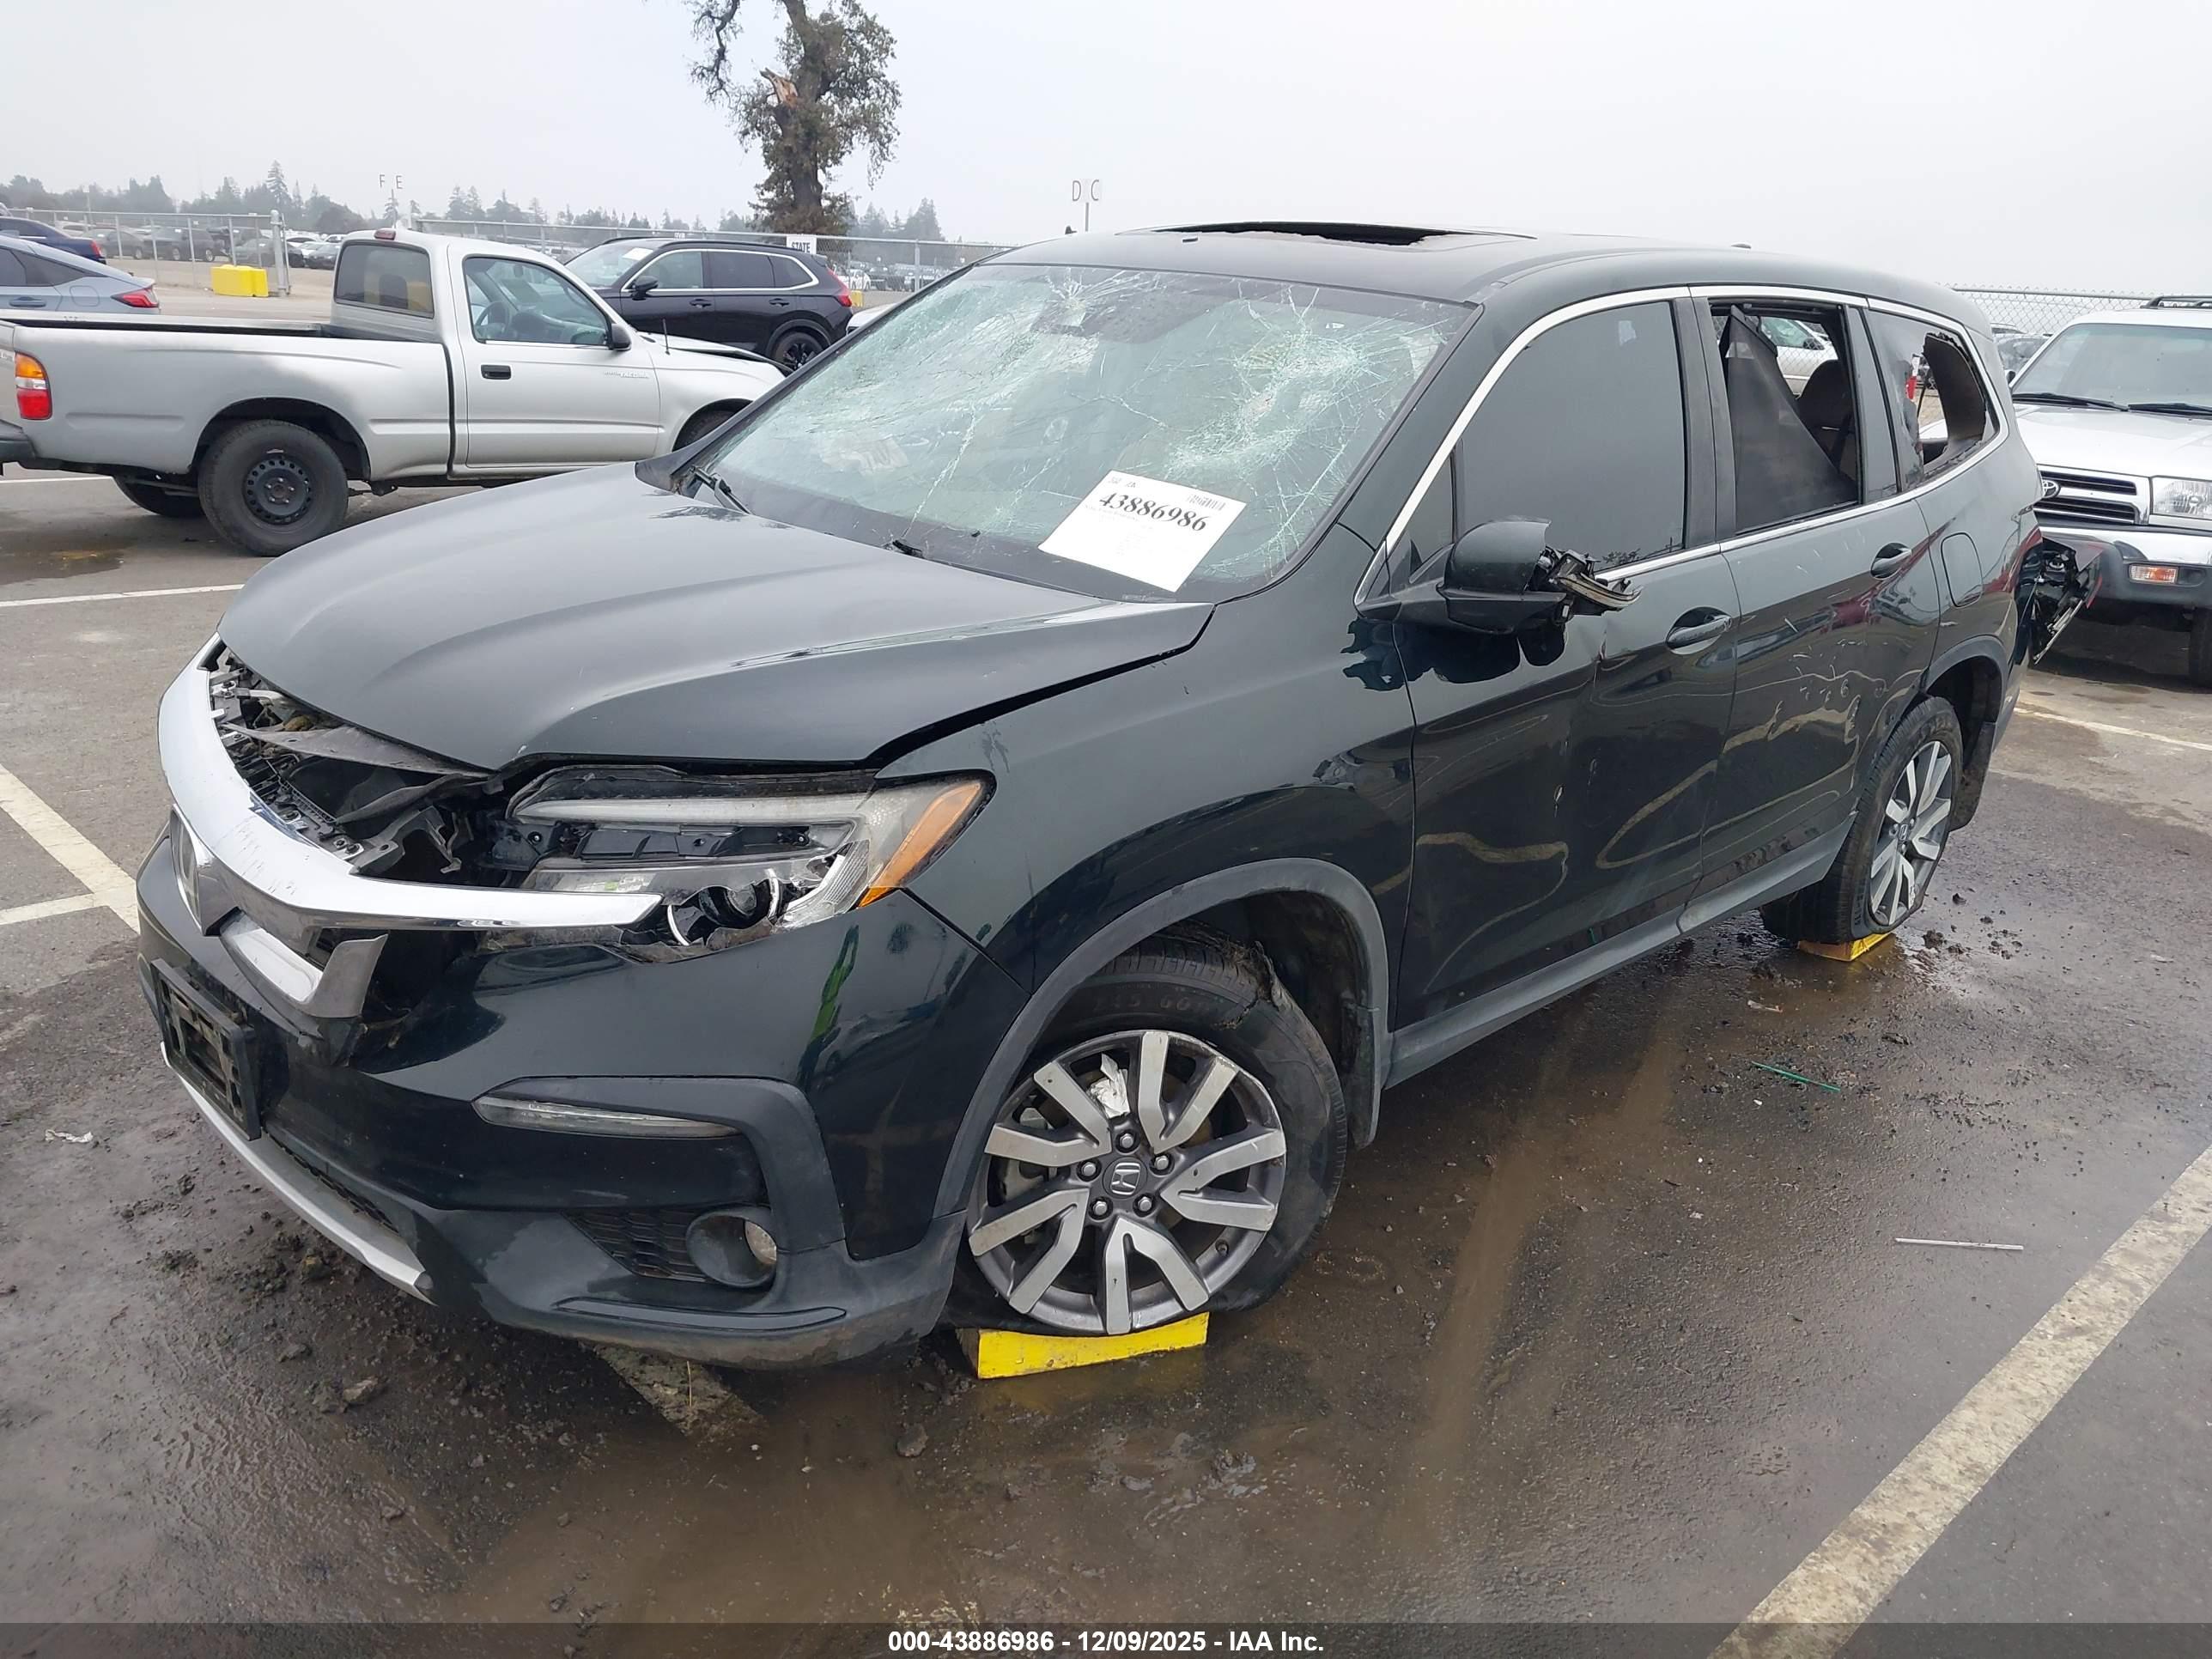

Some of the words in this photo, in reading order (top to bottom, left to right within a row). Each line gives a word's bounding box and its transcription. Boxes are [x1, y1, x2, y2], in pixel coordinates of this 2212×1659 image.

[379, 174, 386, 188] F
[396, 175, 404, 189] E
[1091, 179, 1100, 201] C
[1073, 180, 1081, 202] D
[791, 241, 811, 253] STATE
[1099, 492, 1212, 532] 43886986
